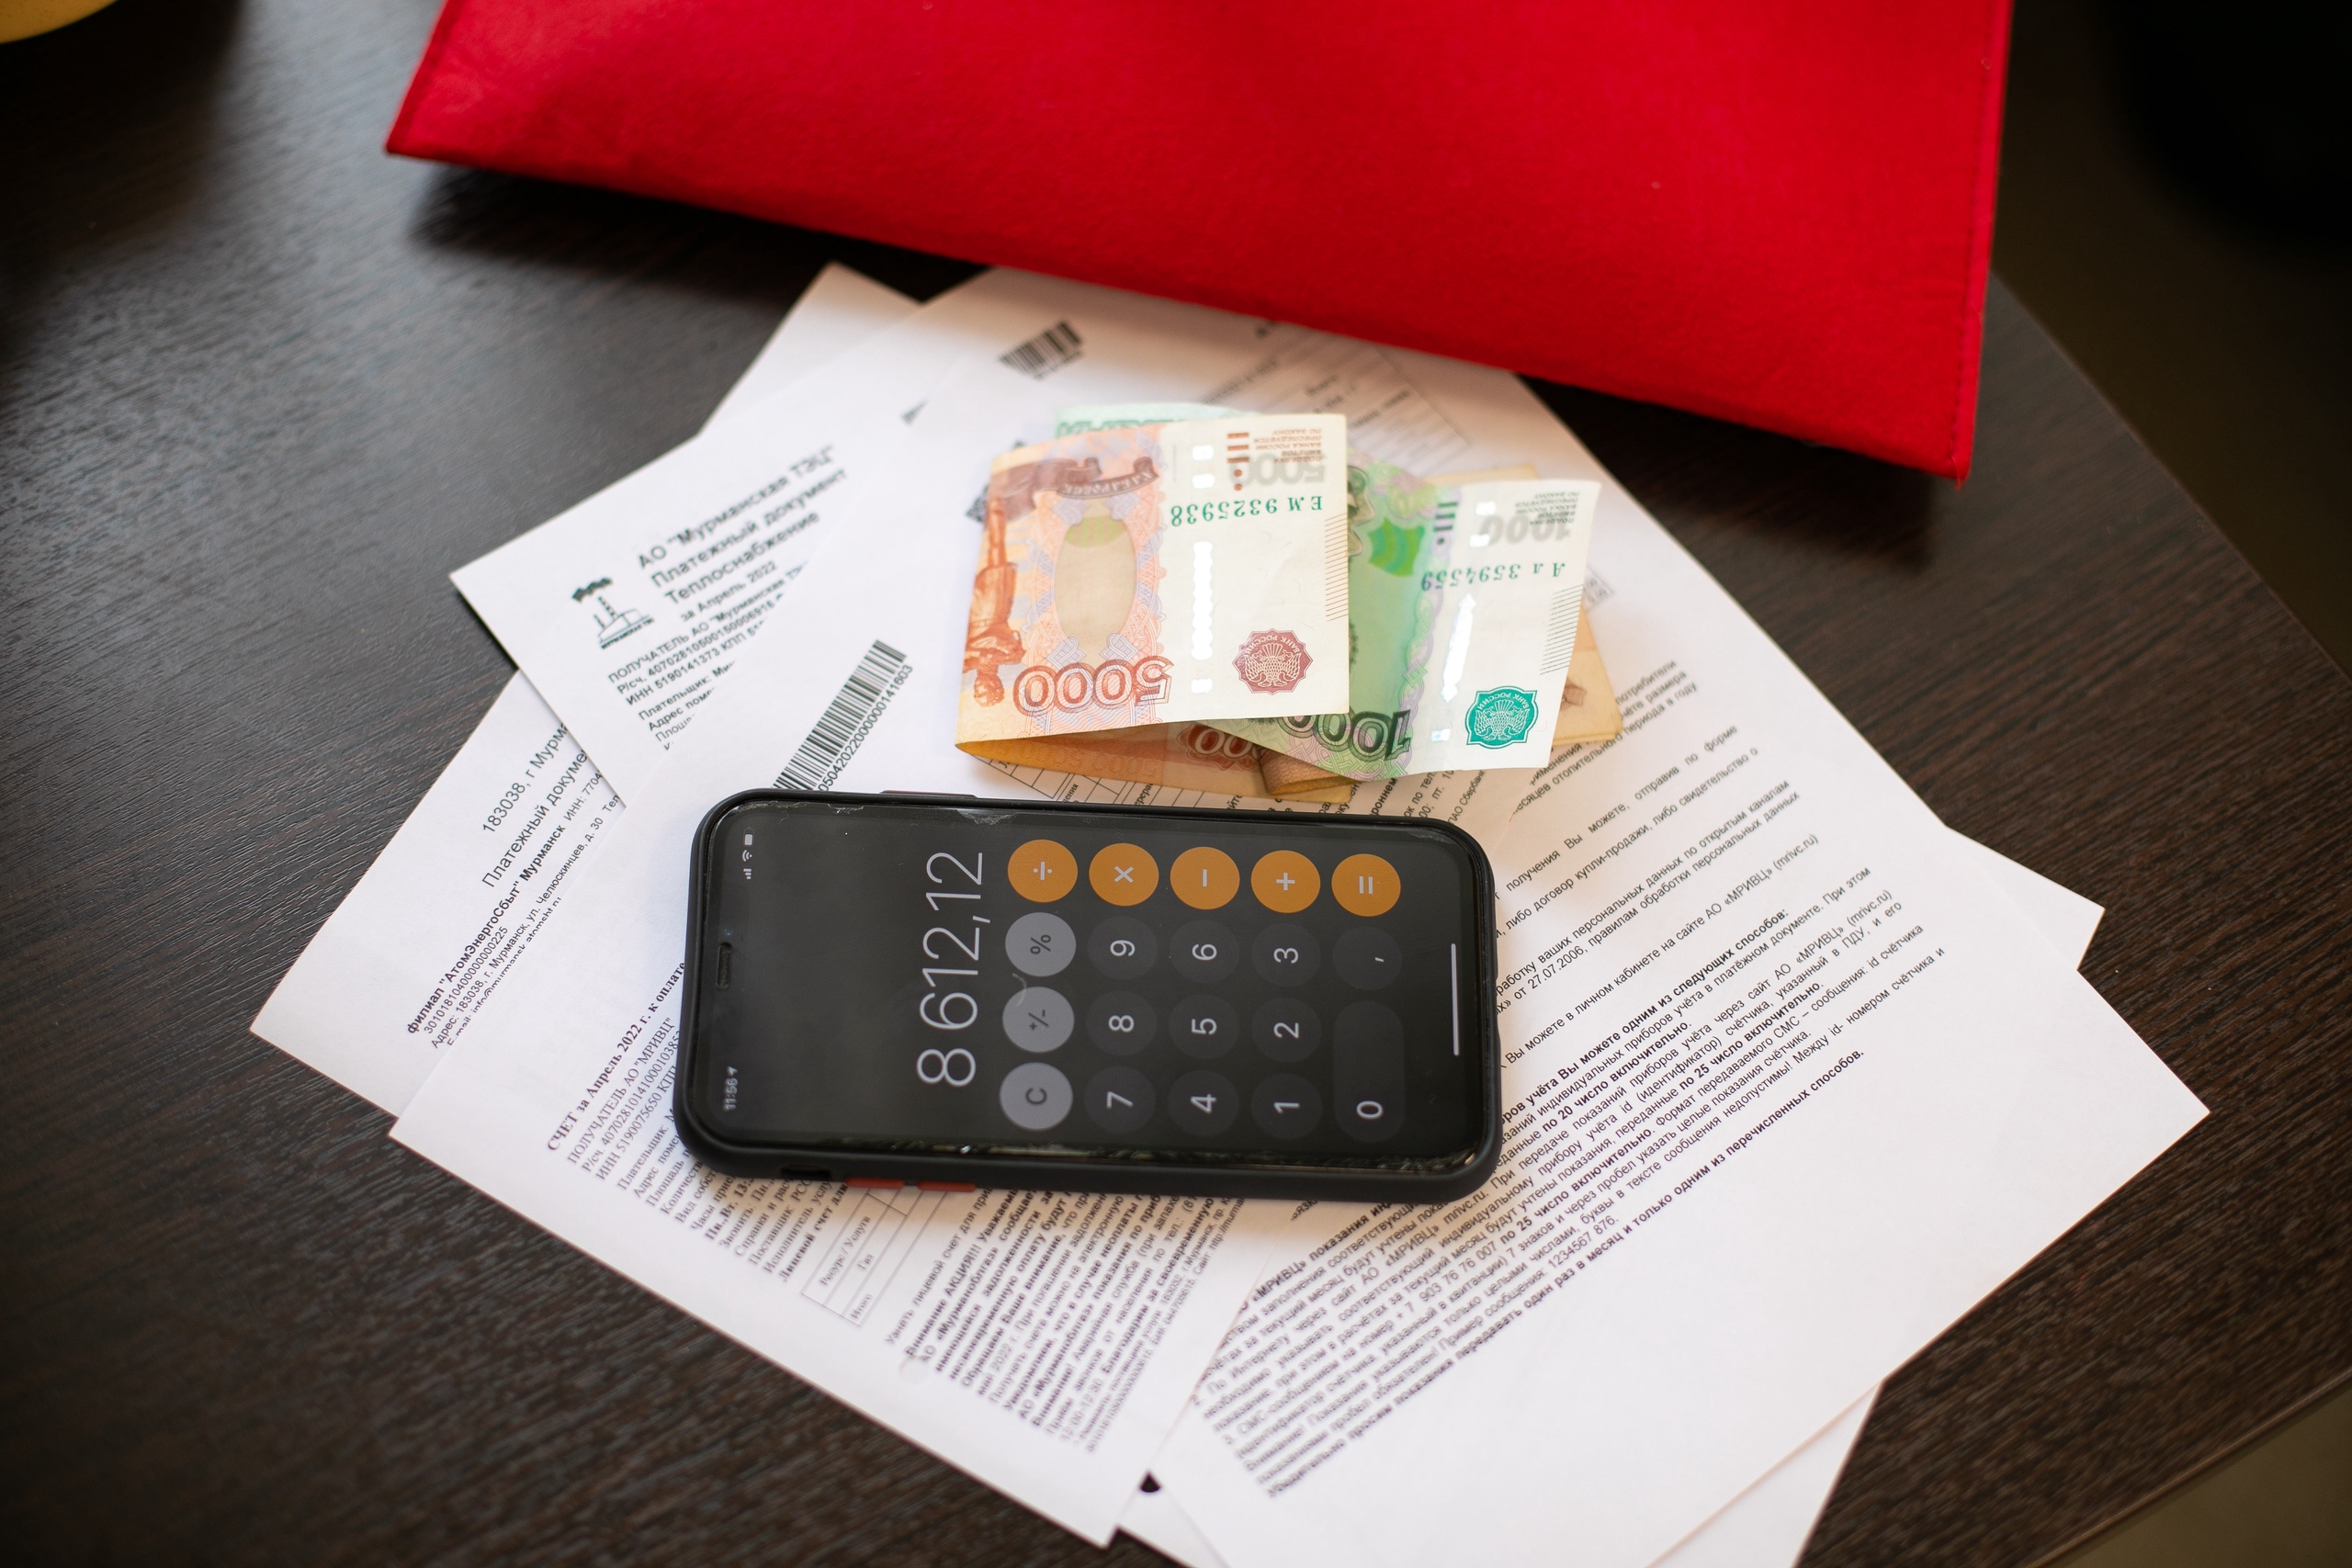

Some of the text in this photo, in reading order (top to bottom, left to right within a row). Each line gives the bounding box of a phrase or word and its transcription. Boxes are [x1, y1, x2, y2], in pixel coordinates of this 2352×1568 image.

[650, 521, 759, 589] Платежный
[763, 468, 847, 527] документ
[663, 512, 820, 604] Теплоснабжение
[1170, 499, 1278, 527] 9325938
[1012, 655, 1174, 716] 5000
[481, 804, 550, 888] Платежный
[482, 782, 532, 833] 183038,
[1458, 770, 1486, 807] Сбербанк
[1505, 850, 1562, 893] получения
[1563, 833, 1584, 850] Вы
[1587, 803, 1631, 834] можете,
[1683, 752, 1700, 766] по
[406, 987, 446, 1034] филиал
[438, 879, 521, 985] "АтомЭнергоСбыт"
[518, 824, 566, 882] Мурманск
[562, 795, 587, 822] ИНН:
[430, 1014, 460, 1050] Адрес:
[455, 979, 489, 1013] 183038,
[488, 922, 531, 970] Мурманск,
[525, 908, 542, 923] ул.
[535, 843, 589, 905] Челюскинцев,
[589, 817, 605, 831] 30
[1505, 824, 1653, 931] либо договор купли-продажи,
[1513, 986, 1528, 1000] от
[1526, 944, 1589, 990] 27.07.2006,
[1587, 907, 1639, 947] правилам
[1639, 869, 1692, 909] обработки
[1691, 818, 1763, 873] персональных
[423, 925, 509, 1035] 30101810400000000225
[1029, 934, 1052, 955] %
[1504, 1047, 1526, 1065] Вы
[1523, 1018, 1566, 1052] можете
[1574, 983, 1615, 1015] личном
[1612, 949, 1661, 987] кабинете
[1659, 938, 1677, 953] на
[1675, 916, 1706, 941] сайте
[1704, 902, 1723, 920] АО
[1724, 868, 1773, 906] «МРИВЦ»
[1772, 833, 1819, 872] (mrivc.ru)
[547, 1111, 578, 1152] СЧЕТ
[575, 1099, 591, 1112] за
[585, 1054, 623, 1100] Апрель
[616, 1023, 643, 1054] 2022
[655, 962, 692, 1003] оплате
[1106, 940, 1136, 1108] 7 8 9
[1190, 943, 1217, 1113] 4 5 6
[1273, 947, 1300, 1113] 1 2 3
[1524, 908, 1789, 1108] учёта Вы можете одним из следующих способов:
[1571, 926, 1845, 1131] показаний приборов учёта через сайт АО «МРИВЦ»
[566, 1016, 676, 1165] ПОЛУЧАТЕЛЬ АО "МРИВЦ"
[1024, 1087, 1048, 1106] C
[1356, 1100, 1384, 1120] 0
[1541, 1021, 1692, 1134] по 20 число включительно.
[1711, 1031, 1812, 1107] показания счётчика.
[594, 1151, 621, 1181] ИНН
[615, 1091, 662, 1154] 5190075650
[1418, 1037, 1774, 1303] 903 76 76 007 по 25 число включительно. Формат передаваемого
[1631, 1050, 1865, 1227] только одним из перечисленных способов.
[1547, 1214, 1620, 1269] 1234567 876.
